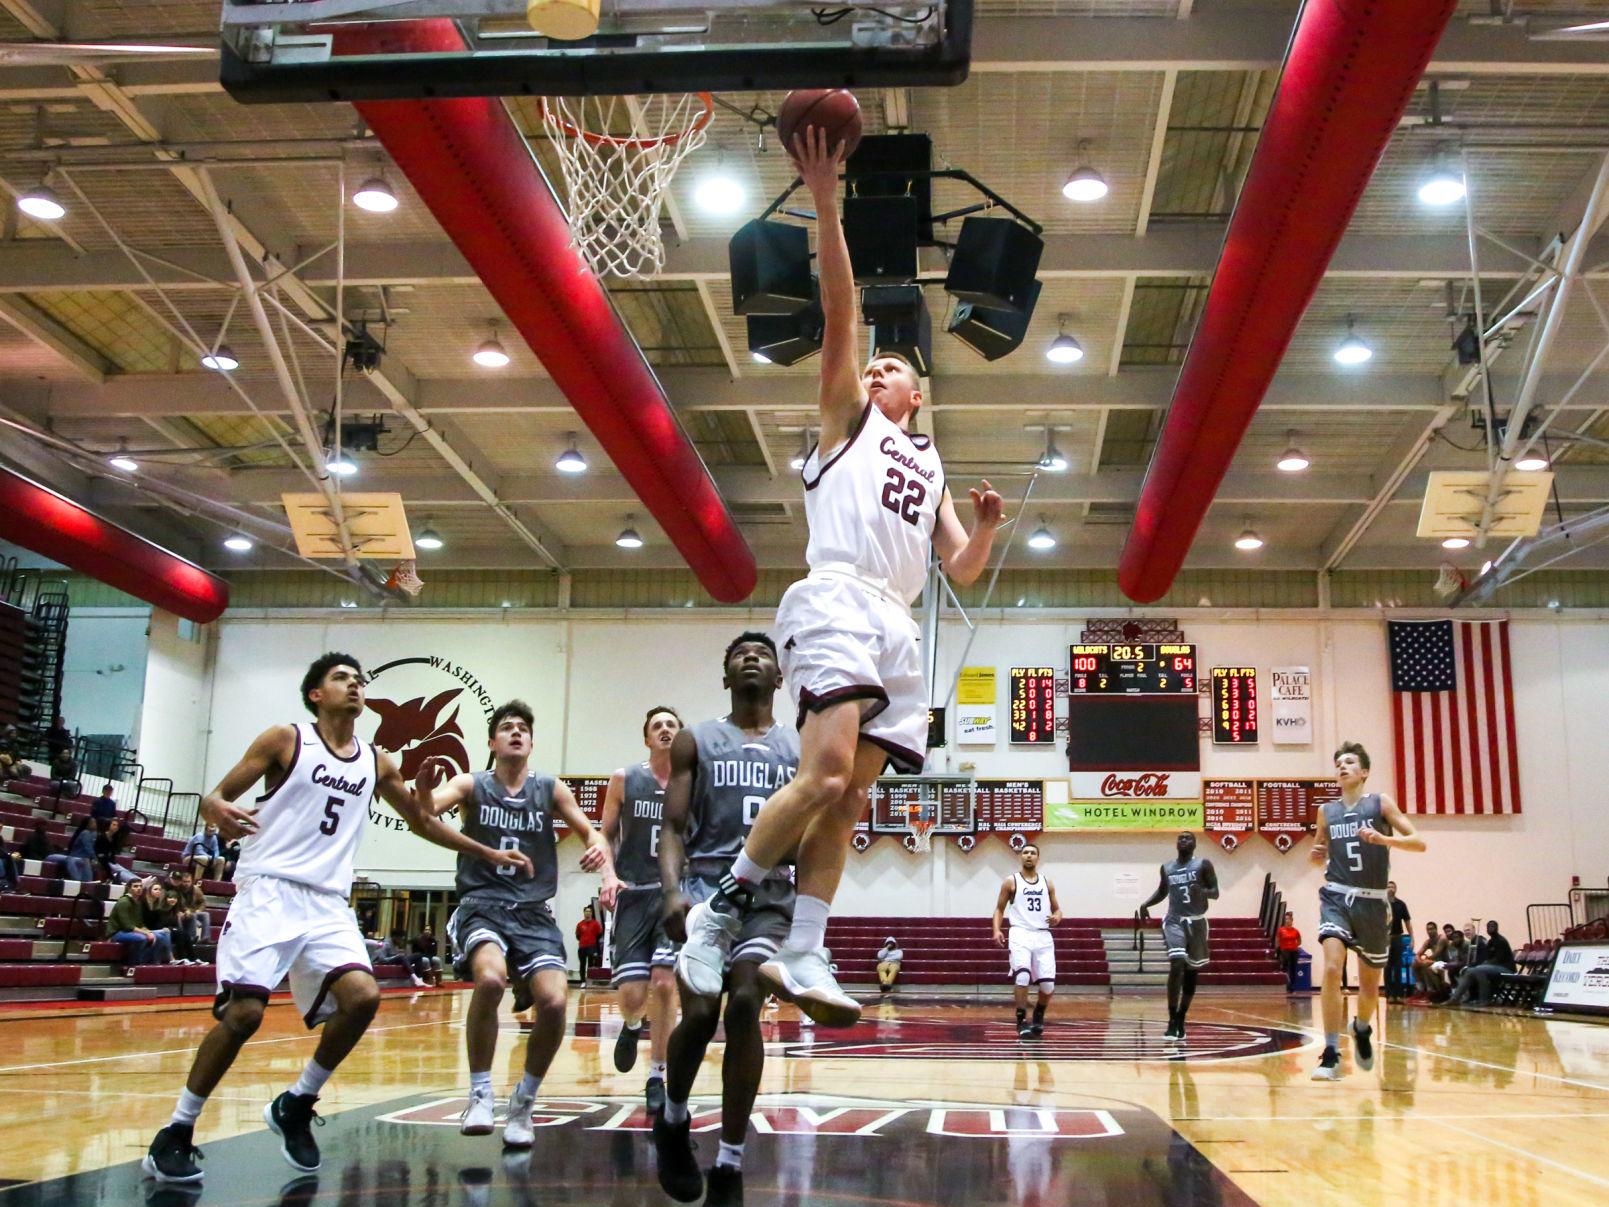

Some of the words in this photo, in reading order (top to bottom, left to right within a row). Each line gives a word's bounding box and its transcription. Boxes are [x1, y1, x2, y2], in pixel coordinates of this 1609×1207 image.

[880, 436, 935, 483] Central
[881, 467, 927, 526] 22
[1113, 646, 1144, 660] 20.5
[1074, 658, 1096, 670] 100
[1137, 662, 1144, 672] 2
[1174, 658, 1192, 670] 64
[1038, 668, 1053, 677] PTS
[1241, 668, 1255, 677] PTS
[1019, 679, 1025, 688] 2
[1029, 679, 1036, 688] 0
[1042, 679, 1052, 688] 14
[1079, 678, 1087, 688] 8
[1099, 678, 1107, 688] 2
[1159, 678, 1167, 688] 2
[1185, 678, 1192, 688] 5
[1222, 679, 1228, 688] 3
[1232, 679, 1239, 688] 3
[1247, 679, 1254, 688] 5
[1272, 672, 1309, 687] PALACE
[1019, 689, 1026, 698] 5
[1029, 689, 1036, 698] 0
[1045, 689, 1052, 698] 0
[1222, 689, 1228, 698] 5
[1232, 689, 1239, 698] 3
[1248, 689, 1254, 698] 7
[1013, 700, 1026, 709] 22
[1029, 700, 1036, 709] 0
[1045, 700, 1052, 709] 2
[1222, 700, 1229, 709] 6
[1232, 700, 1239, 709] 3
[1248, 700, 1255, 709] 0
[959, 716, 992, 725] SUBWAY
[1013, 711, 1026, 720] 33
[1045, 711, 1053, 720] 8
[1222, 711, 1229, 720] 8
[1232, 711, 1239, 720] 0
[1248, 711, 1255, 720] 2
[1013, 722, 1026, 731] 42
[1045, 722, 1053, 731] 2
[1222, 722, 1230, 730] 9
[1233, 722, 1239, 730] 2
[1245, 722, 1256, 730] 17
[1029, 732, 1036, 741] 8
[1233, 732, 1240, 741] 5
[311, 764, 367, 796] Central
[319, 795, 345, 836] 5
[1084, 807, 1127, 817] HOTEL
[1131, 807, 1198, 817] WINDROW
[480, 804, 544, 832] DOUGLAS
[1346, 841, 1363, 872] 5
[1023, 887, 1043, 895] Central
[1179, 885, 1191, 903] 3
[1027, 897, 1041, 911] 33
